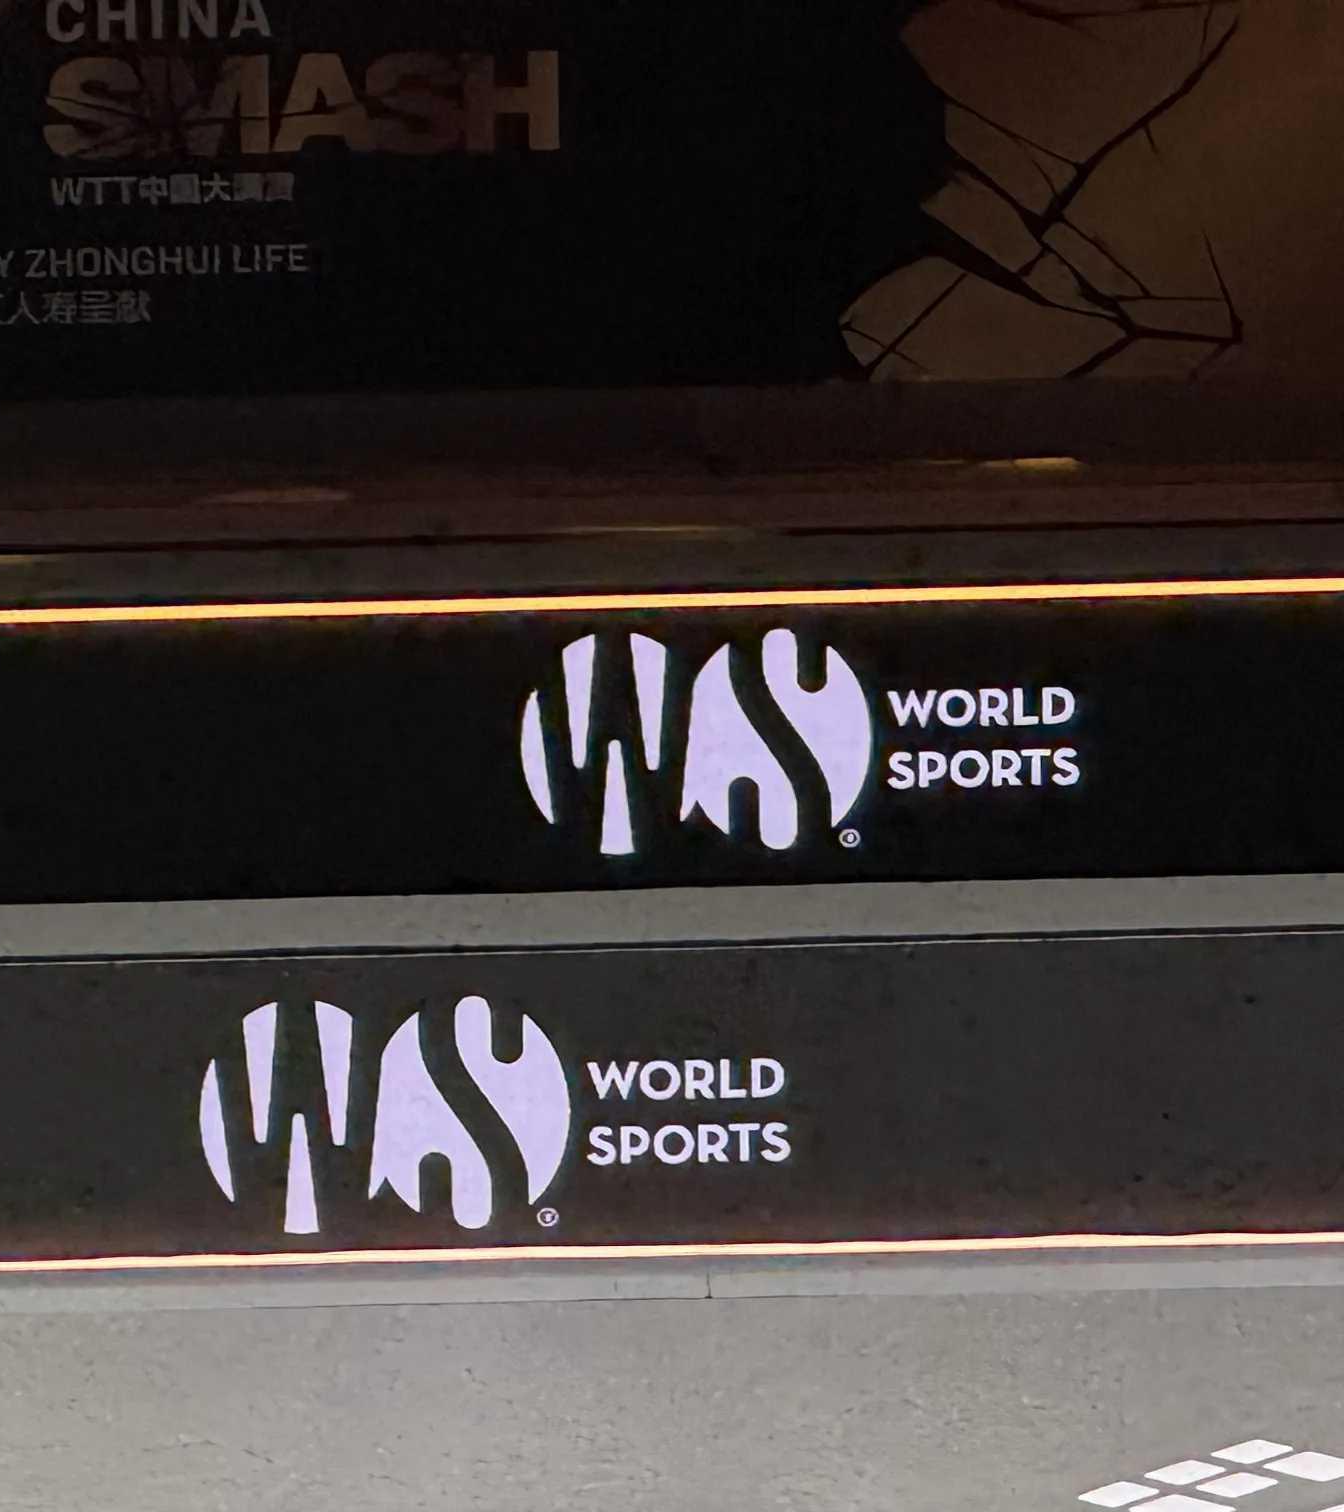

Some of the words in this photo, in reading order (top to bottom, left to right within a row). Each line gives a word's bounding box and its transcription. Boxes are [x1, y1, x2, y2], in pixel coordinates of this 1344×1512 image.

[45, 0, 272, 42] CHINA
[44, 50, 560, 157] SMASH
[24, 244, 223, 279] ZHONGHUI
[231, 243, 310, 274] LIFE
[887, 686, 1075, 728] WORLD
[887, 747, 1080, 790] SPORTS
[587, 1057, 785, 1101] WORLD
[587, 1122, 791, 1166] SPORTS
